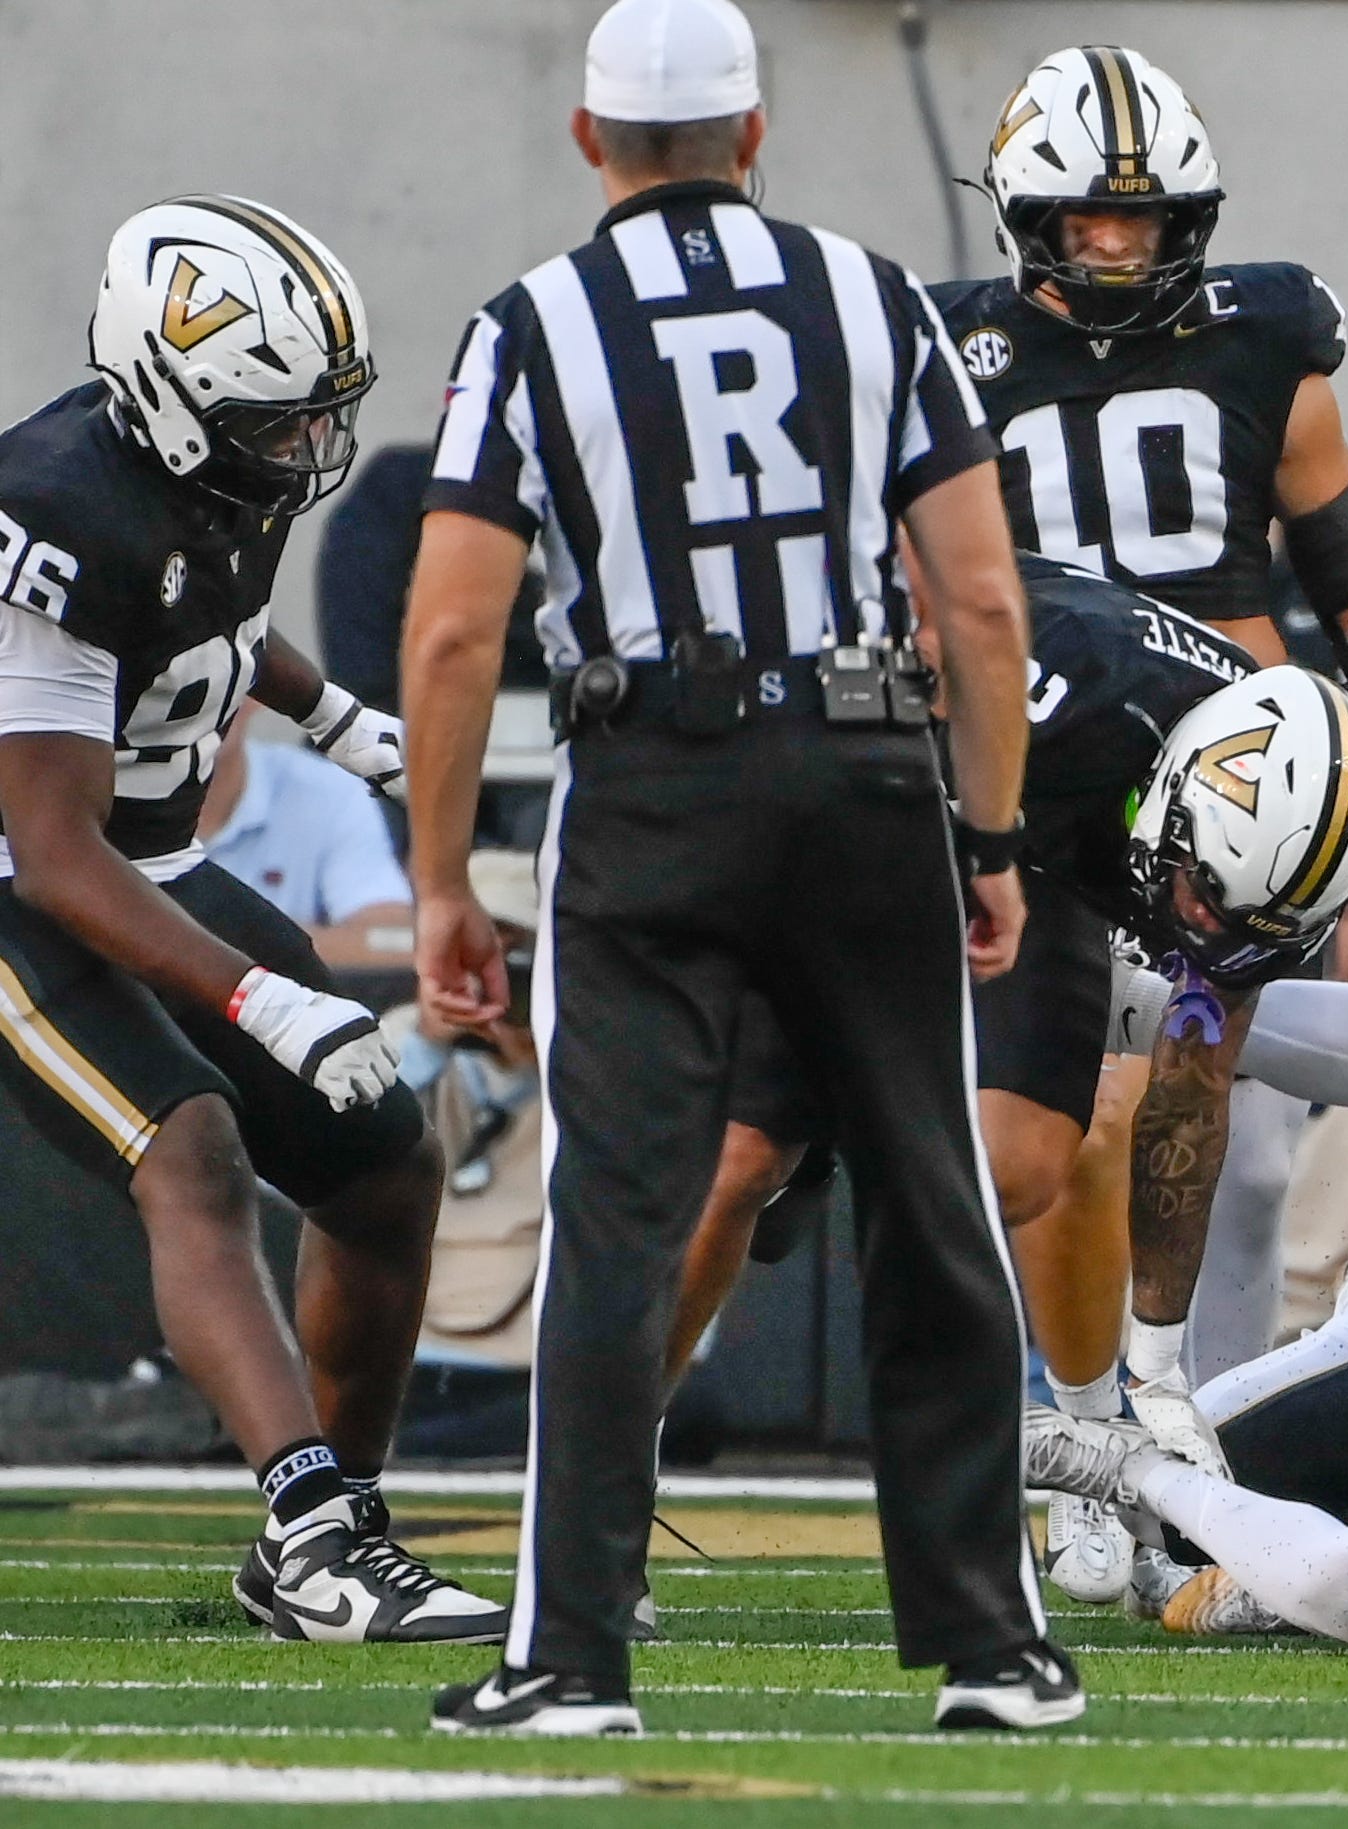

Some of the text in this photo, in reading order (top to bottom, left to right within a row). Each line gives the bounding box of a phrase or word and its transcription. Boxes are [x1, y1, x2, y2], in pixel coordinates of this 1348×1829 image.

[1108, 177, 1150, 193] VUFB
[160, 251, 258, 354] V
[1204, 279, 1239, 316] C
[963, 331, 1010, 377] SEC
[1089, 338, 1112, 360] V
[650, 308, 825, 525] R
[1001, 386, 1228, 578] 10
[759, 670, 785, 704] S
[1194, 722, 1280, 822] V
